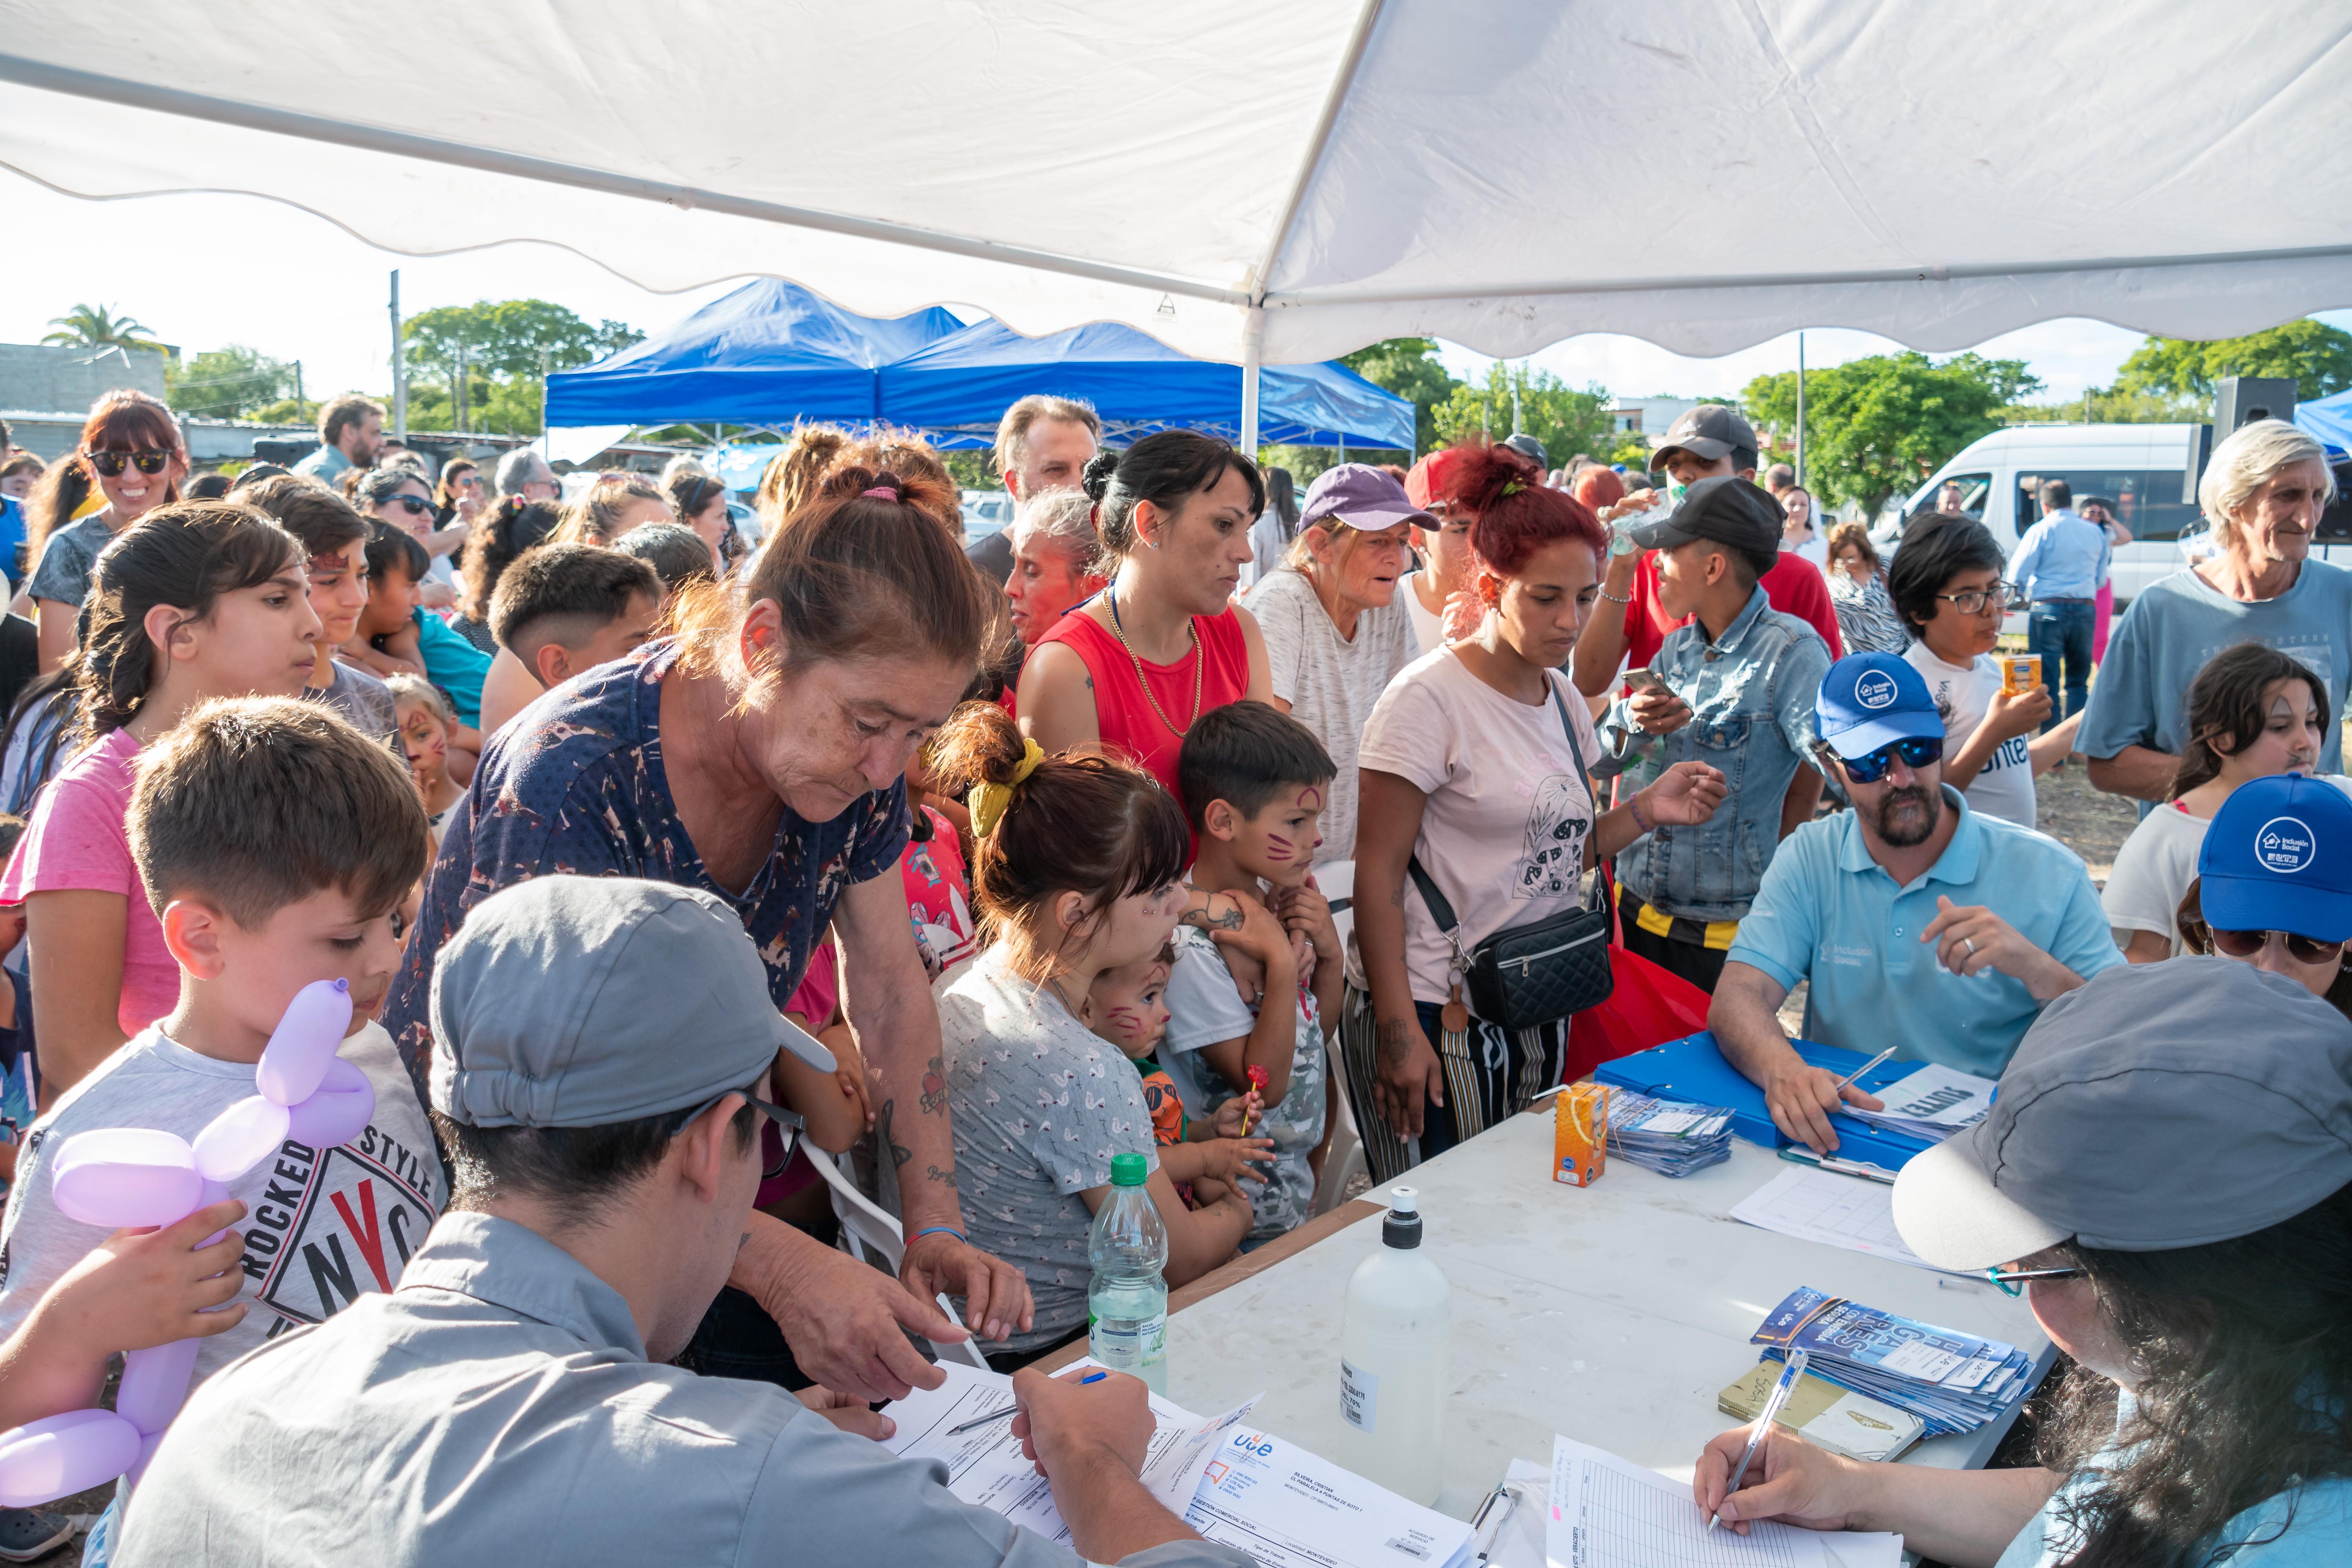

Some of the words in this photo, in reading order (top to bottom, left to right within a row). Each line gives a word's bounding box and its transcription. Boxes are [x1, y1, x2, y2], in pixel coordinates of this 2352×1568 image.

[2282, 837, 2308, 847] Inclusión
[2282, 844, 2300, 852] Social
[360, 1125, 431, 1198] STYLE
[239, 1140, 315, 1280] ROCKED
[1777, 1313, 1794, 1326] ute
[1817, 1305, 1849, 1325] SEGURA
[1833, 1314, 1896, 1352] RES
[1348, 1385, 1365, 1401] 2200.6176
[1350, 1397, 1361, 1408] 70%
[1233, 1476, 1251, 1487] ute.com.uy
[1294, 1472, 1313, 1484] SILVEIRA,
[1314, 1481, 1334, 1493] CRISTIAN
[1284, 1483, 1309, 1497] MONTEVIDEO
[1296, 1479, 1318, 1492] PARALELA
[1323, 1491, 1340, 1502] PUNTAS
[1347, 1503, 1359, 1511] SOTO
[1191, 1514, 1206, 1524] Trámite
[1196, 1499, 1215, 1511] GESTIÓN
[1215, 1507, 1240, 1523] COMERCIAL
[1240, 1519, 1257, 1530] SOCIAL
[1408, 1529, 1429, 1539] ACUERDO
[1409, 1533, 1428, 1544] SERVICIO
[1218, 1537, 1236, 1548] Contrato
[1242, 1548, 1265, 1562] Suministro
[1253, 1543, 1263, 1552] Tipo
[1269, 1550, 1286, 1560] Trámite
[1285, 1540, 1307, 1553] Localidad:
[1307, 1549, 1338, 1565] MONTEVIDEO
[1412, 1542, 1427, 1551] Cuenta
